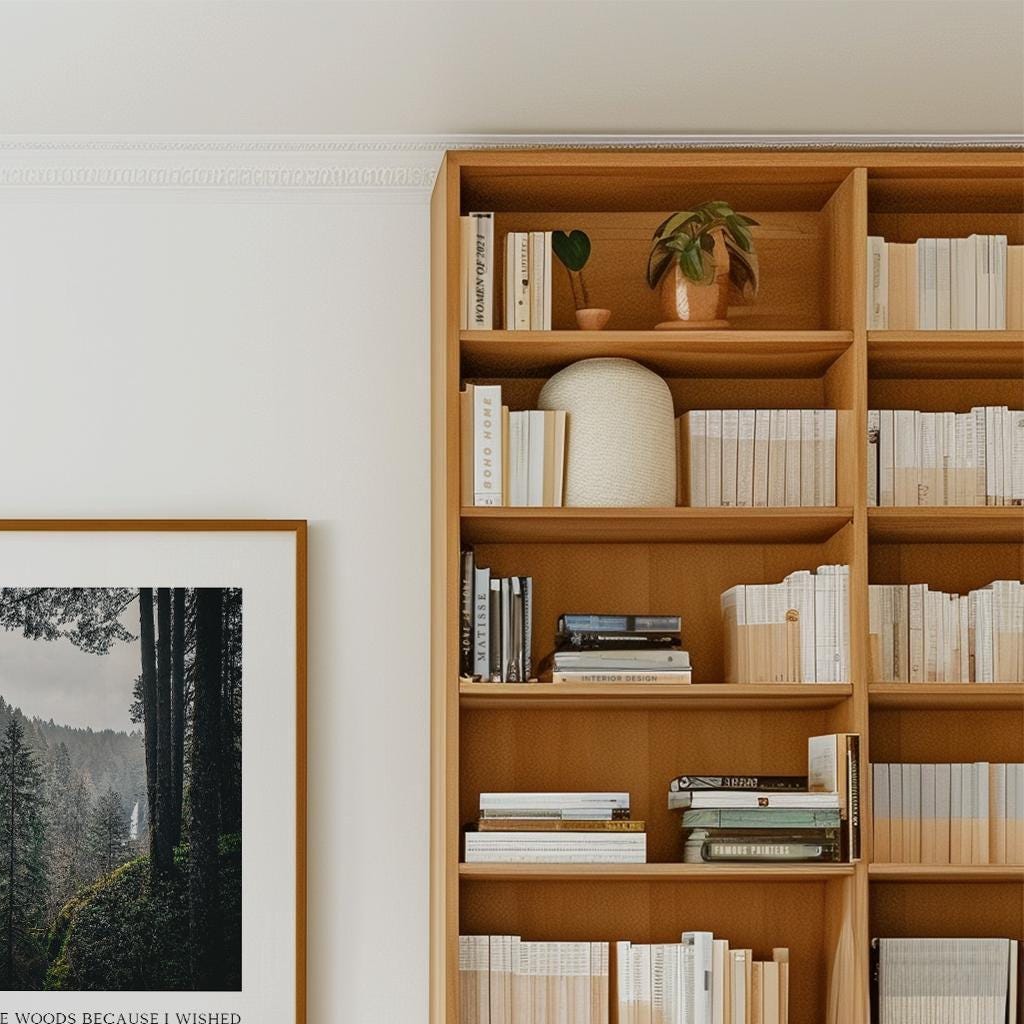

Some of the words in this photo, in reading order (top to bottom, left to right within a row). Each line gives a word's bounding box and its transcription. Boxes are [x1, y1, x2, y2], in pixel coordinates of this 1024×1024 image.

[475, 234, 485, 258] 2024
[475, 258, 486, 276] OF
[475, 275, 485, 323] WOMEN
[482, 397, 492, 440] HOME
[482, 447, 492, 489] BOHO
[477, 592, 487, 662] MATISSE
[714, 846, 748, 855] FAMOUS
[751, 846, 790, 855] PAINTERS
[14, 1012, 77, 1024] WOODS
[82, 1012, 159, 1024] BECAUSE
[164, 1012, 169, 1024] I
[175, 1012, 242, 1024] WISHED
